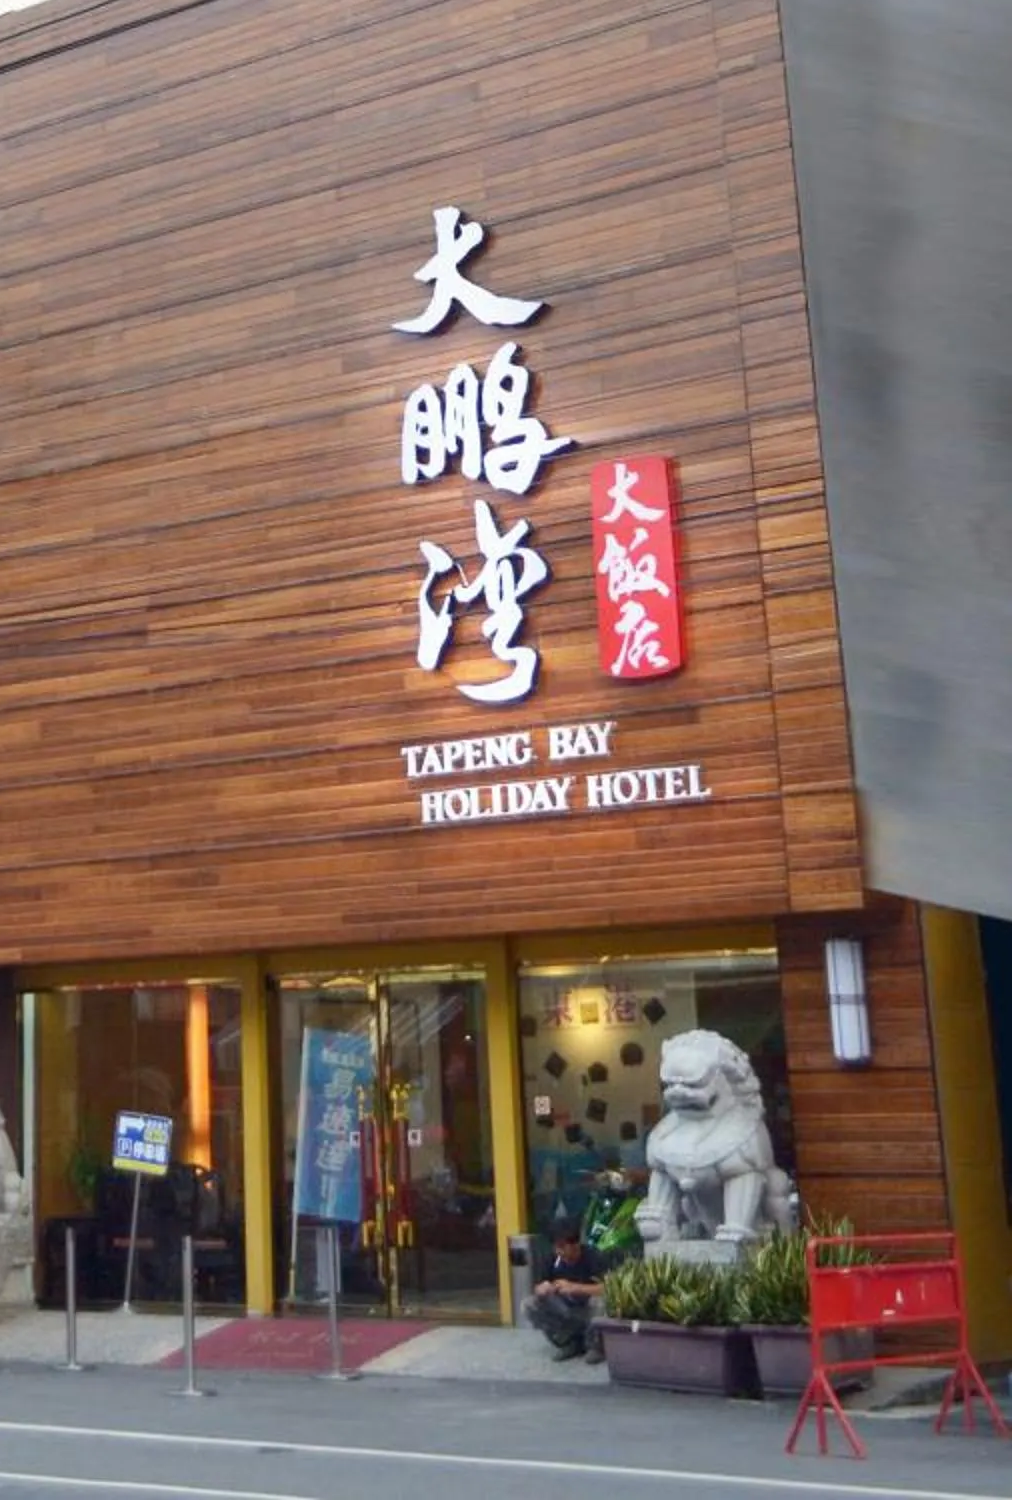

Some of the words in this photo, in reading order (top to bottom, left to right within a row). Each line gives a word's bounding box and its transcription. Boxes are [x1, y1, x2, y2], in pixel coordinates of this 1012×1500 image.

[392, 206, 574, 703] 大鵬灣
[599, 463, 671, 677] 大飯店
[401, 731, 533, 777] TAPENG
[548, 722, 615, 760] BAY
[421, 778, 571, 825] HOLIDAY
[587, 766, 712, 808] HOTEL
